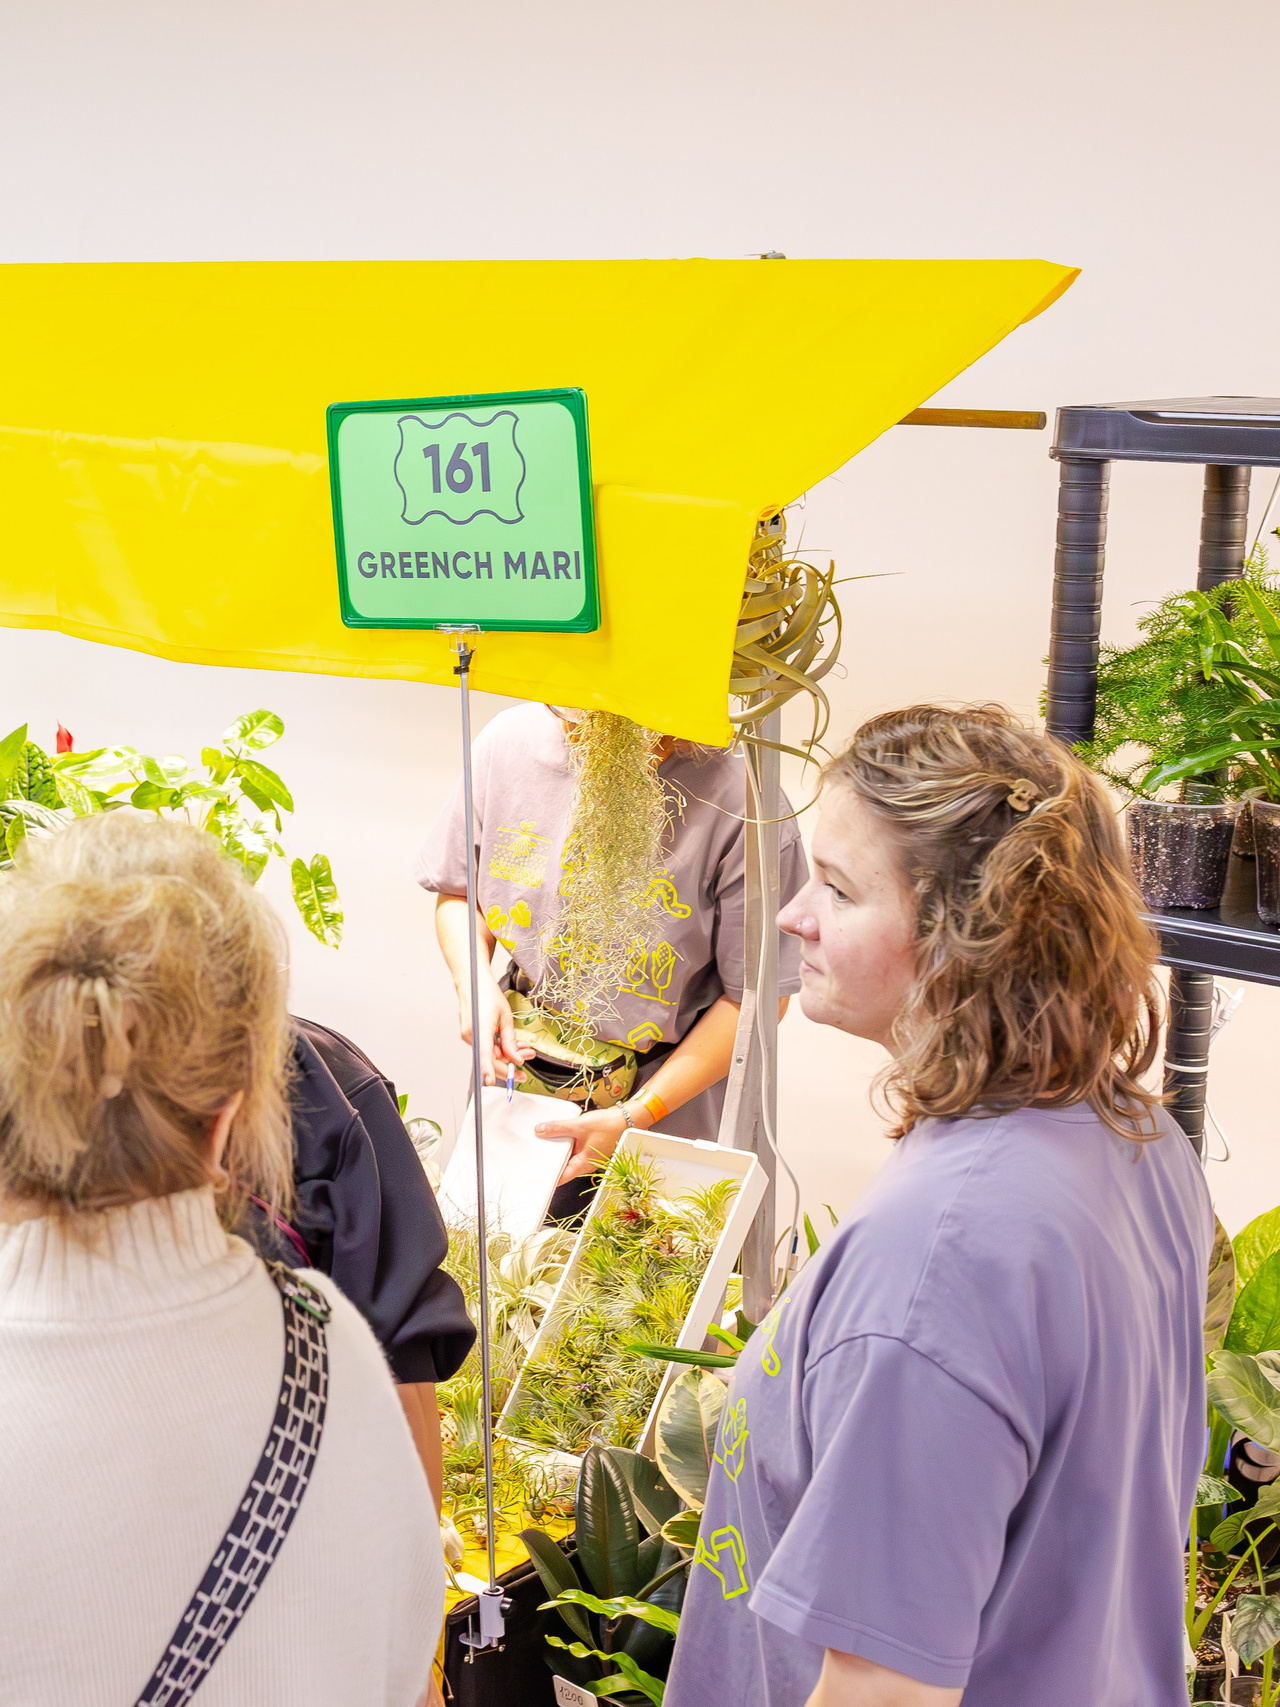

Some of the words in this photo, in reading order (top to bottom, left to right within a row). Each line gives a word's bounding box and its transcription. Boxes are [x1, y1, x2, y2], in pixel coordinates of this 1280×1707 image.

[422, 441, 492, 494] 161
[357, 550, 493, 579] GREENCH
[504, 550, 581, 580] MARI
